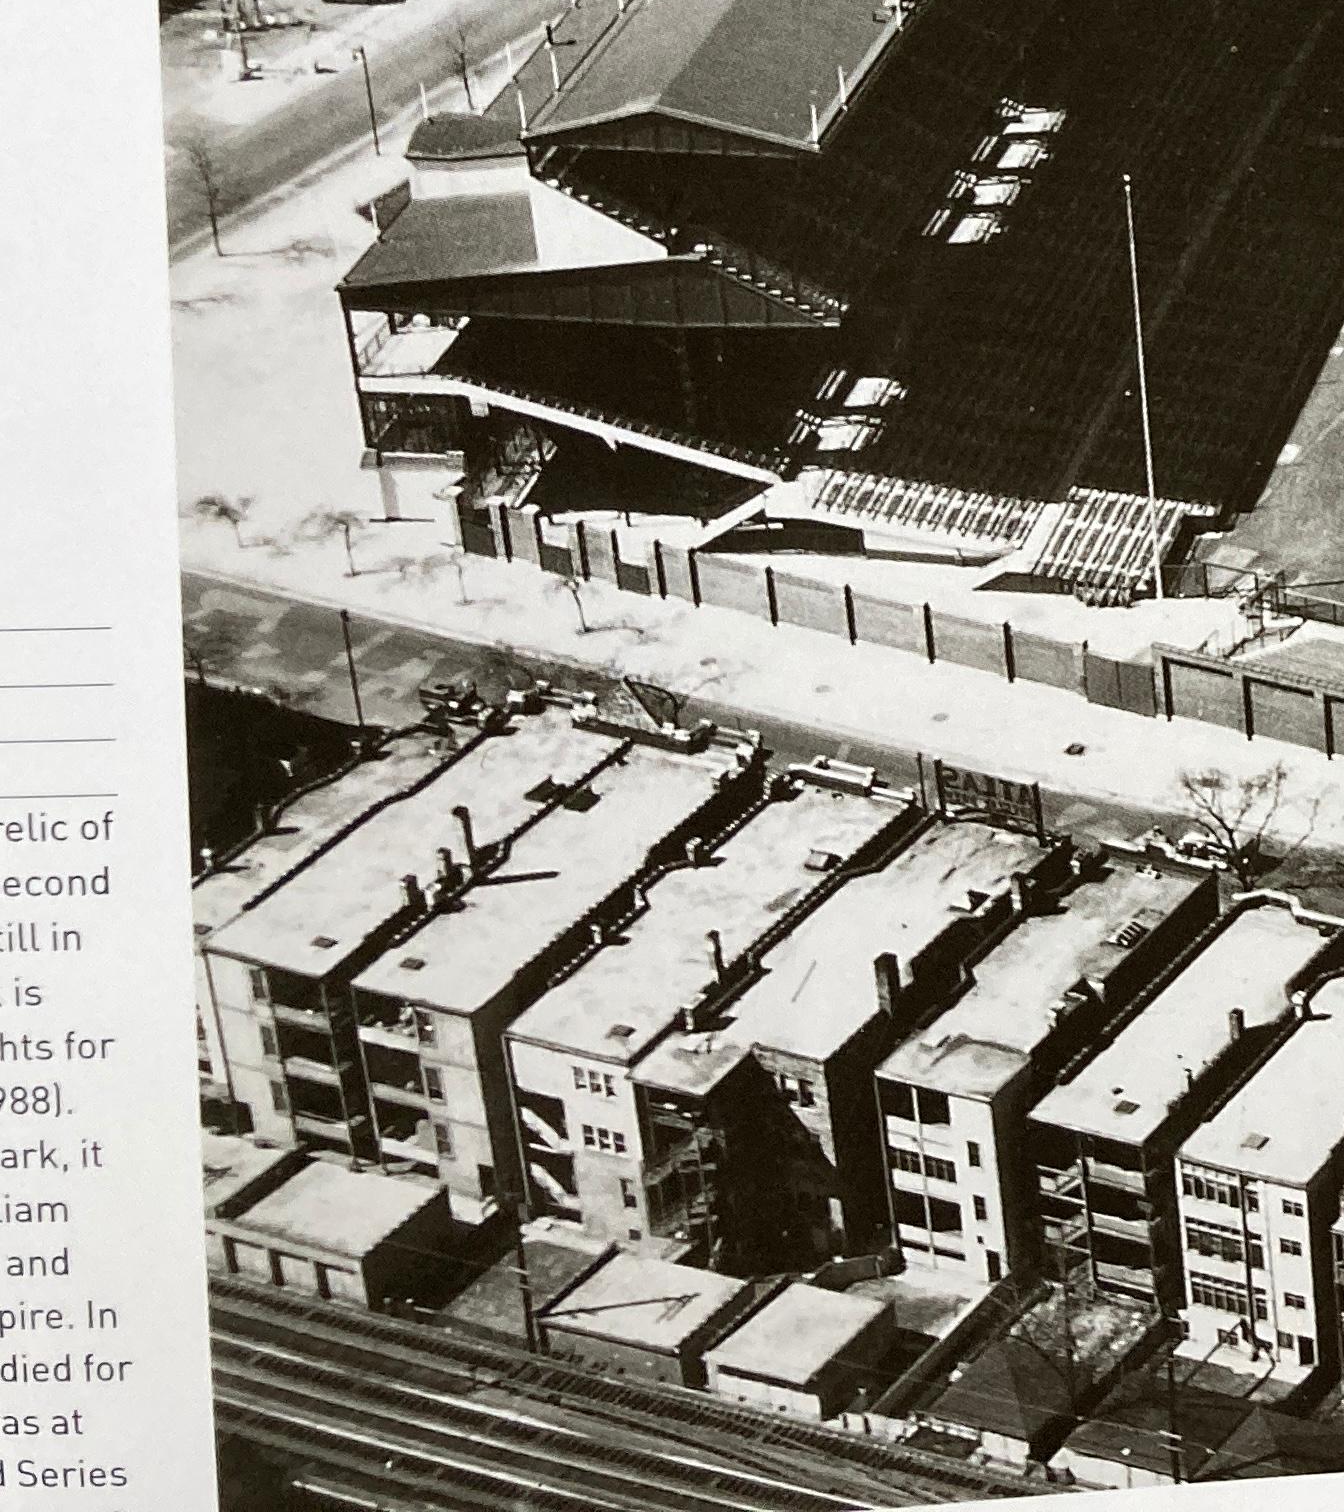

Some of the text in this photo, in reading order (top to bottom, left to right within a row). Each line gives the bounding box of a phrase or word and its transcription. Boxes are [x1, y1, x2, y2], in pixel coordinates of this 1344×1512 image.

[81, 811, 114, 841] of
[52, 922, 82, 952] in
[15, 977, 42, 1007] is
[65, 1030, 115, 1060] for
[82, 1138, 103, 1168] it
[7, 1248, 69, 1276] and
[88, 1300, 117, 1329] In
[84, 1353, 133, 1382] for
[51, 1409, 84, 1435] at
[17, 1459, 128, 1488] Series
